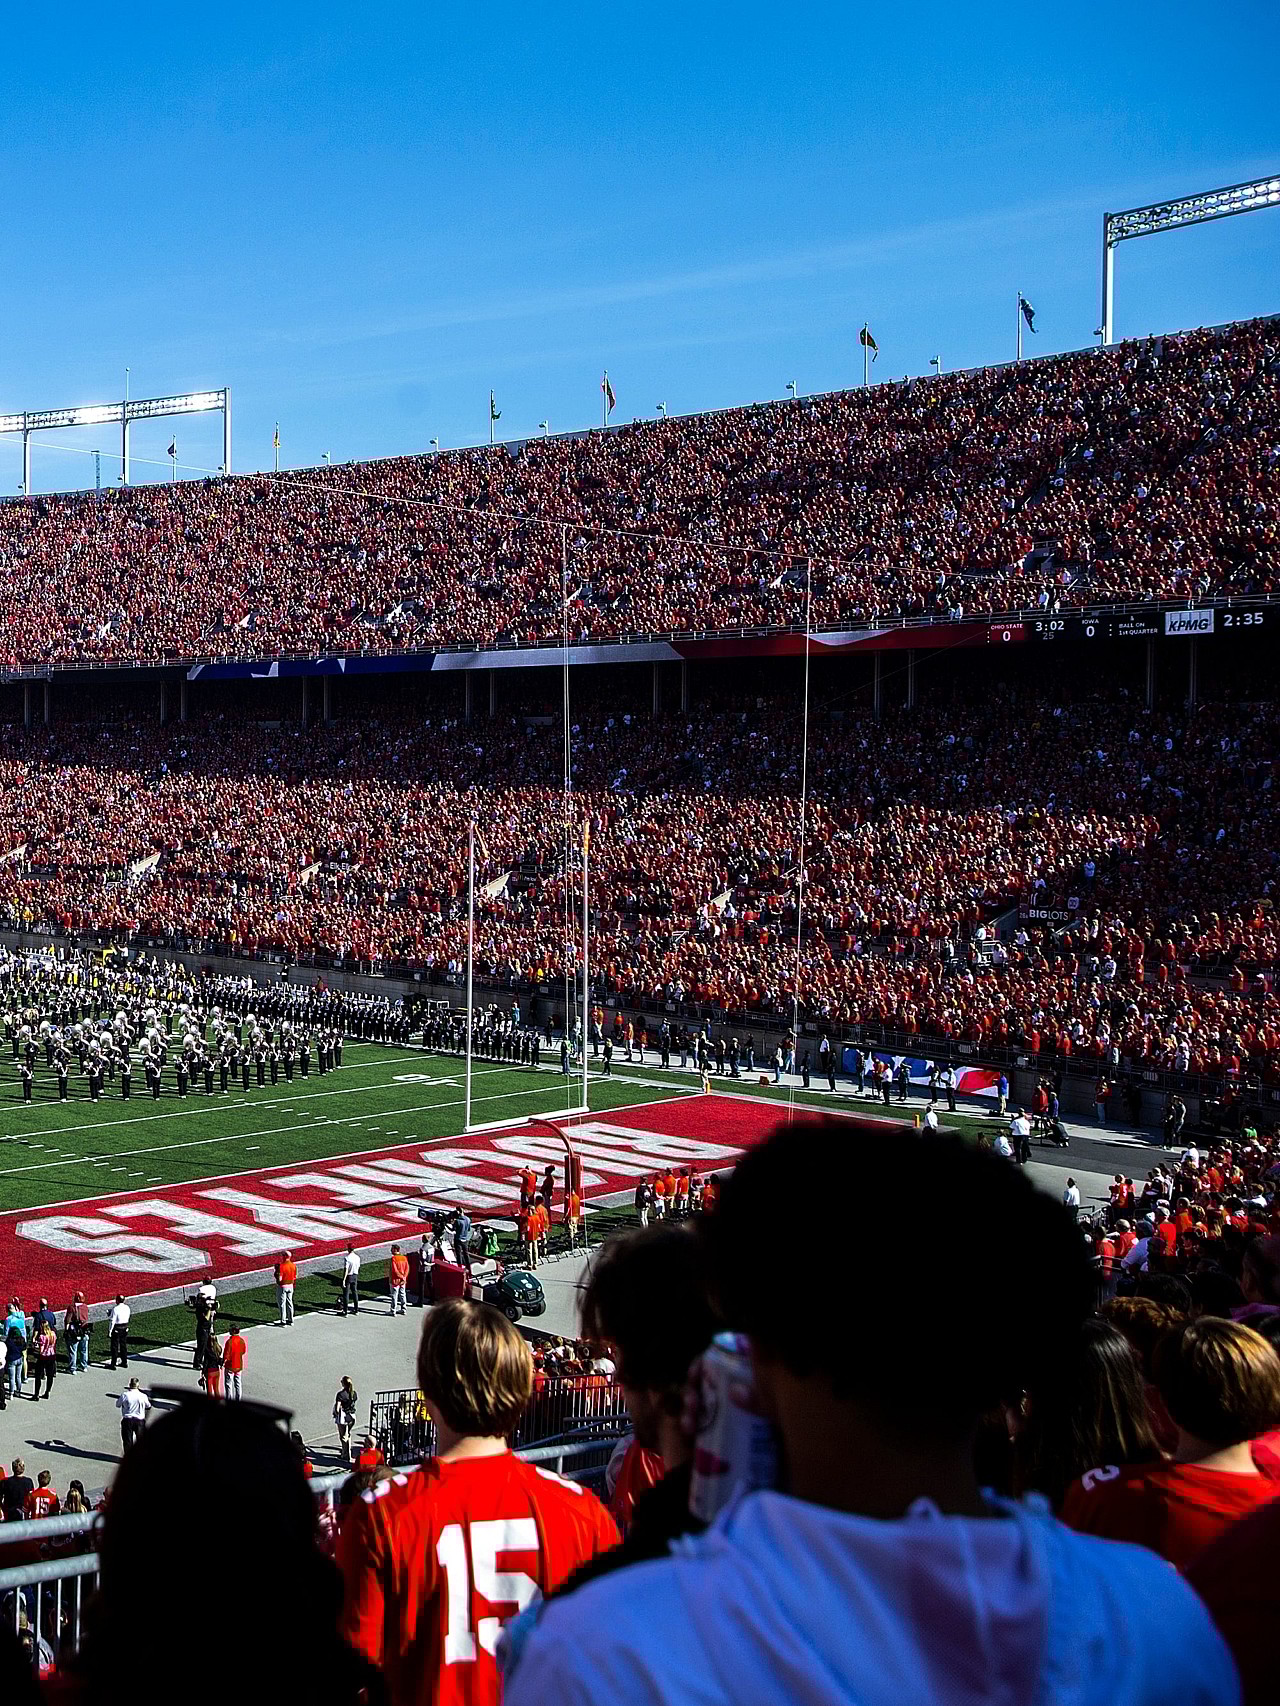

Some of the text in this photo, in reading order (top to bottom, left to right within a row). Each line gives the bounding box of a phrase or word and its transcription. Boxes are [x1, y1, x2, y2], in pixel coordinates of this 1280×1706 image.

[1168, 618, 1209, 632] KPMG
[1223, 612, 1264, 627] 2:35
[1035, 620, 1065, 632] 3:02
[1086, 625, 1095, 637] 0
[1129, 628, 1158, 636] QUARTER
[1002, 631, 1011, 641] 0
[1042, 632, 1054, 640] 25
[1029, 909, 1048, 919] BIG
[1048, 911, 1069, 921] LOTS
[15, 1121, 748, 1274] BUCKEYES
[436, 1517, 544, 1666] 15
